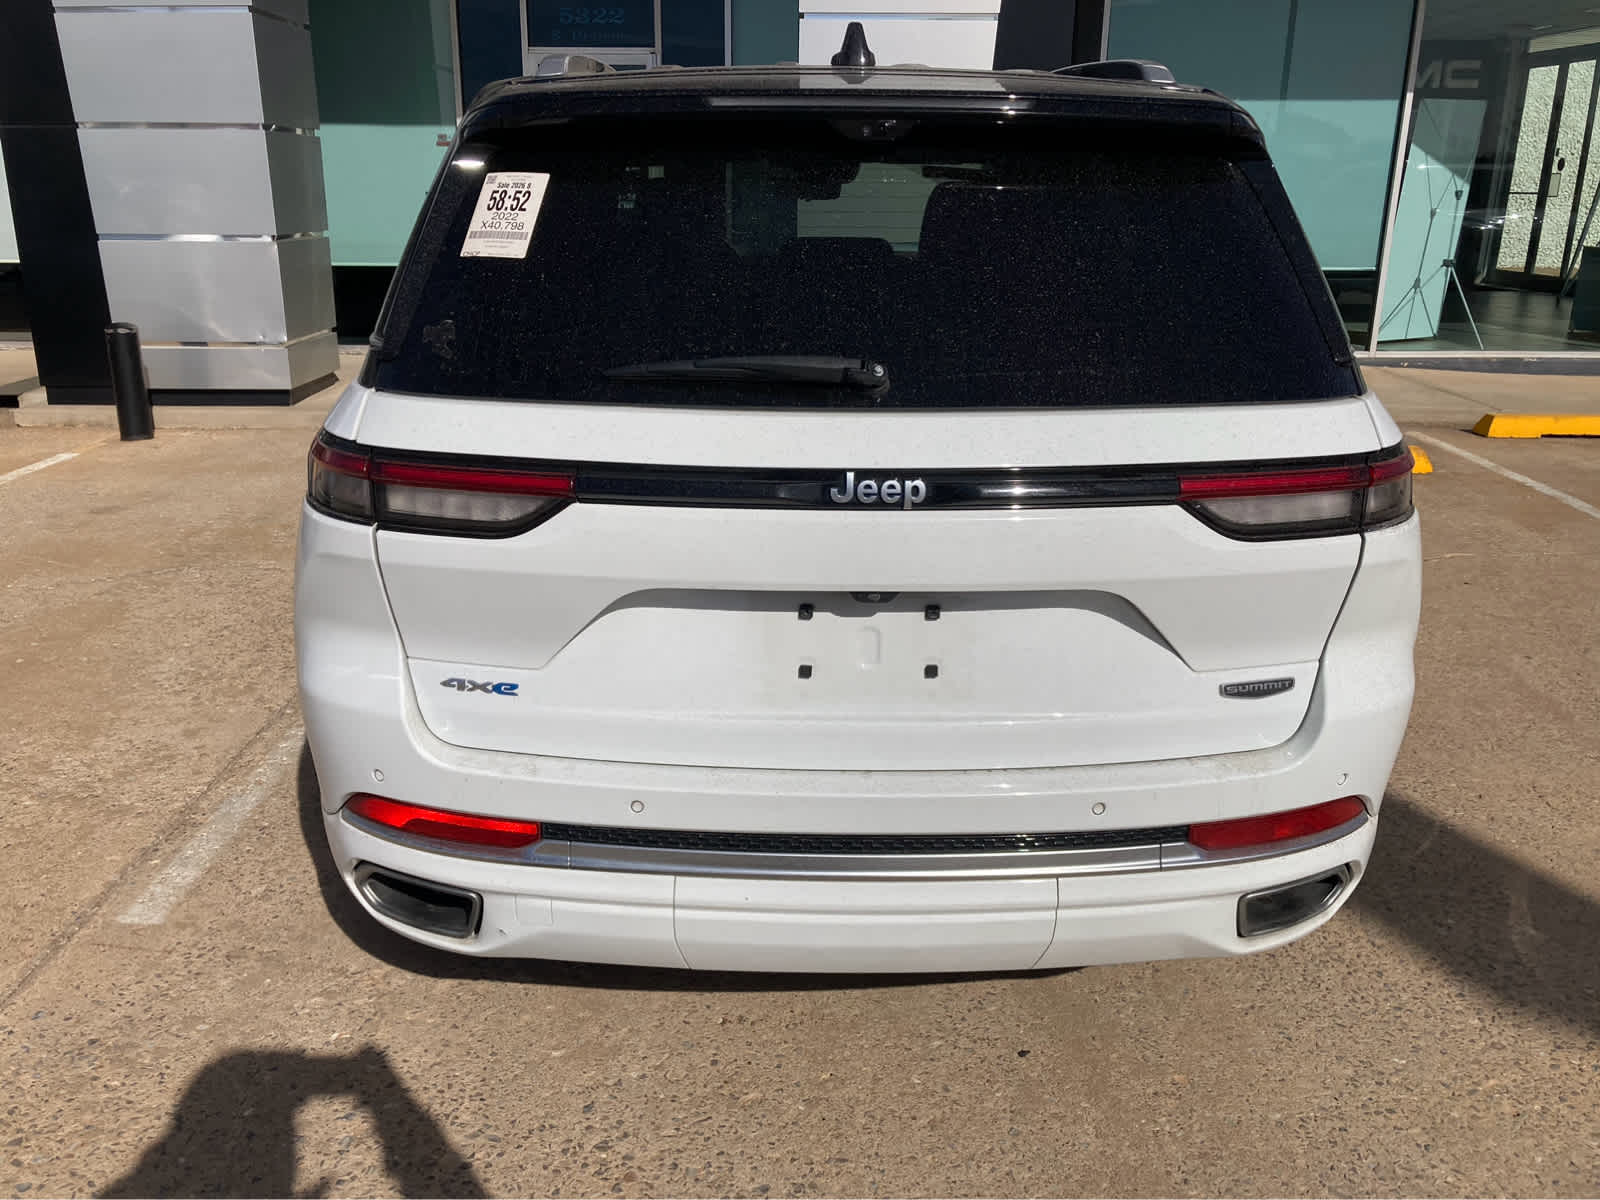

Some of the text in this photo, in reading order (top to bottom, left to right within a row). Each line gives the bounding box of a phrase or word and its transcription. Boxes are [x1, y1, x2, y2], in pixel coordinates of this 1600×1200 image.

[487, 190, 532, 212] 58:52
[491, 212, 519, 221] 2022
[830, 471, 927, 510] Jeep
[1226, 681, 1291, 693] SUMMIT
